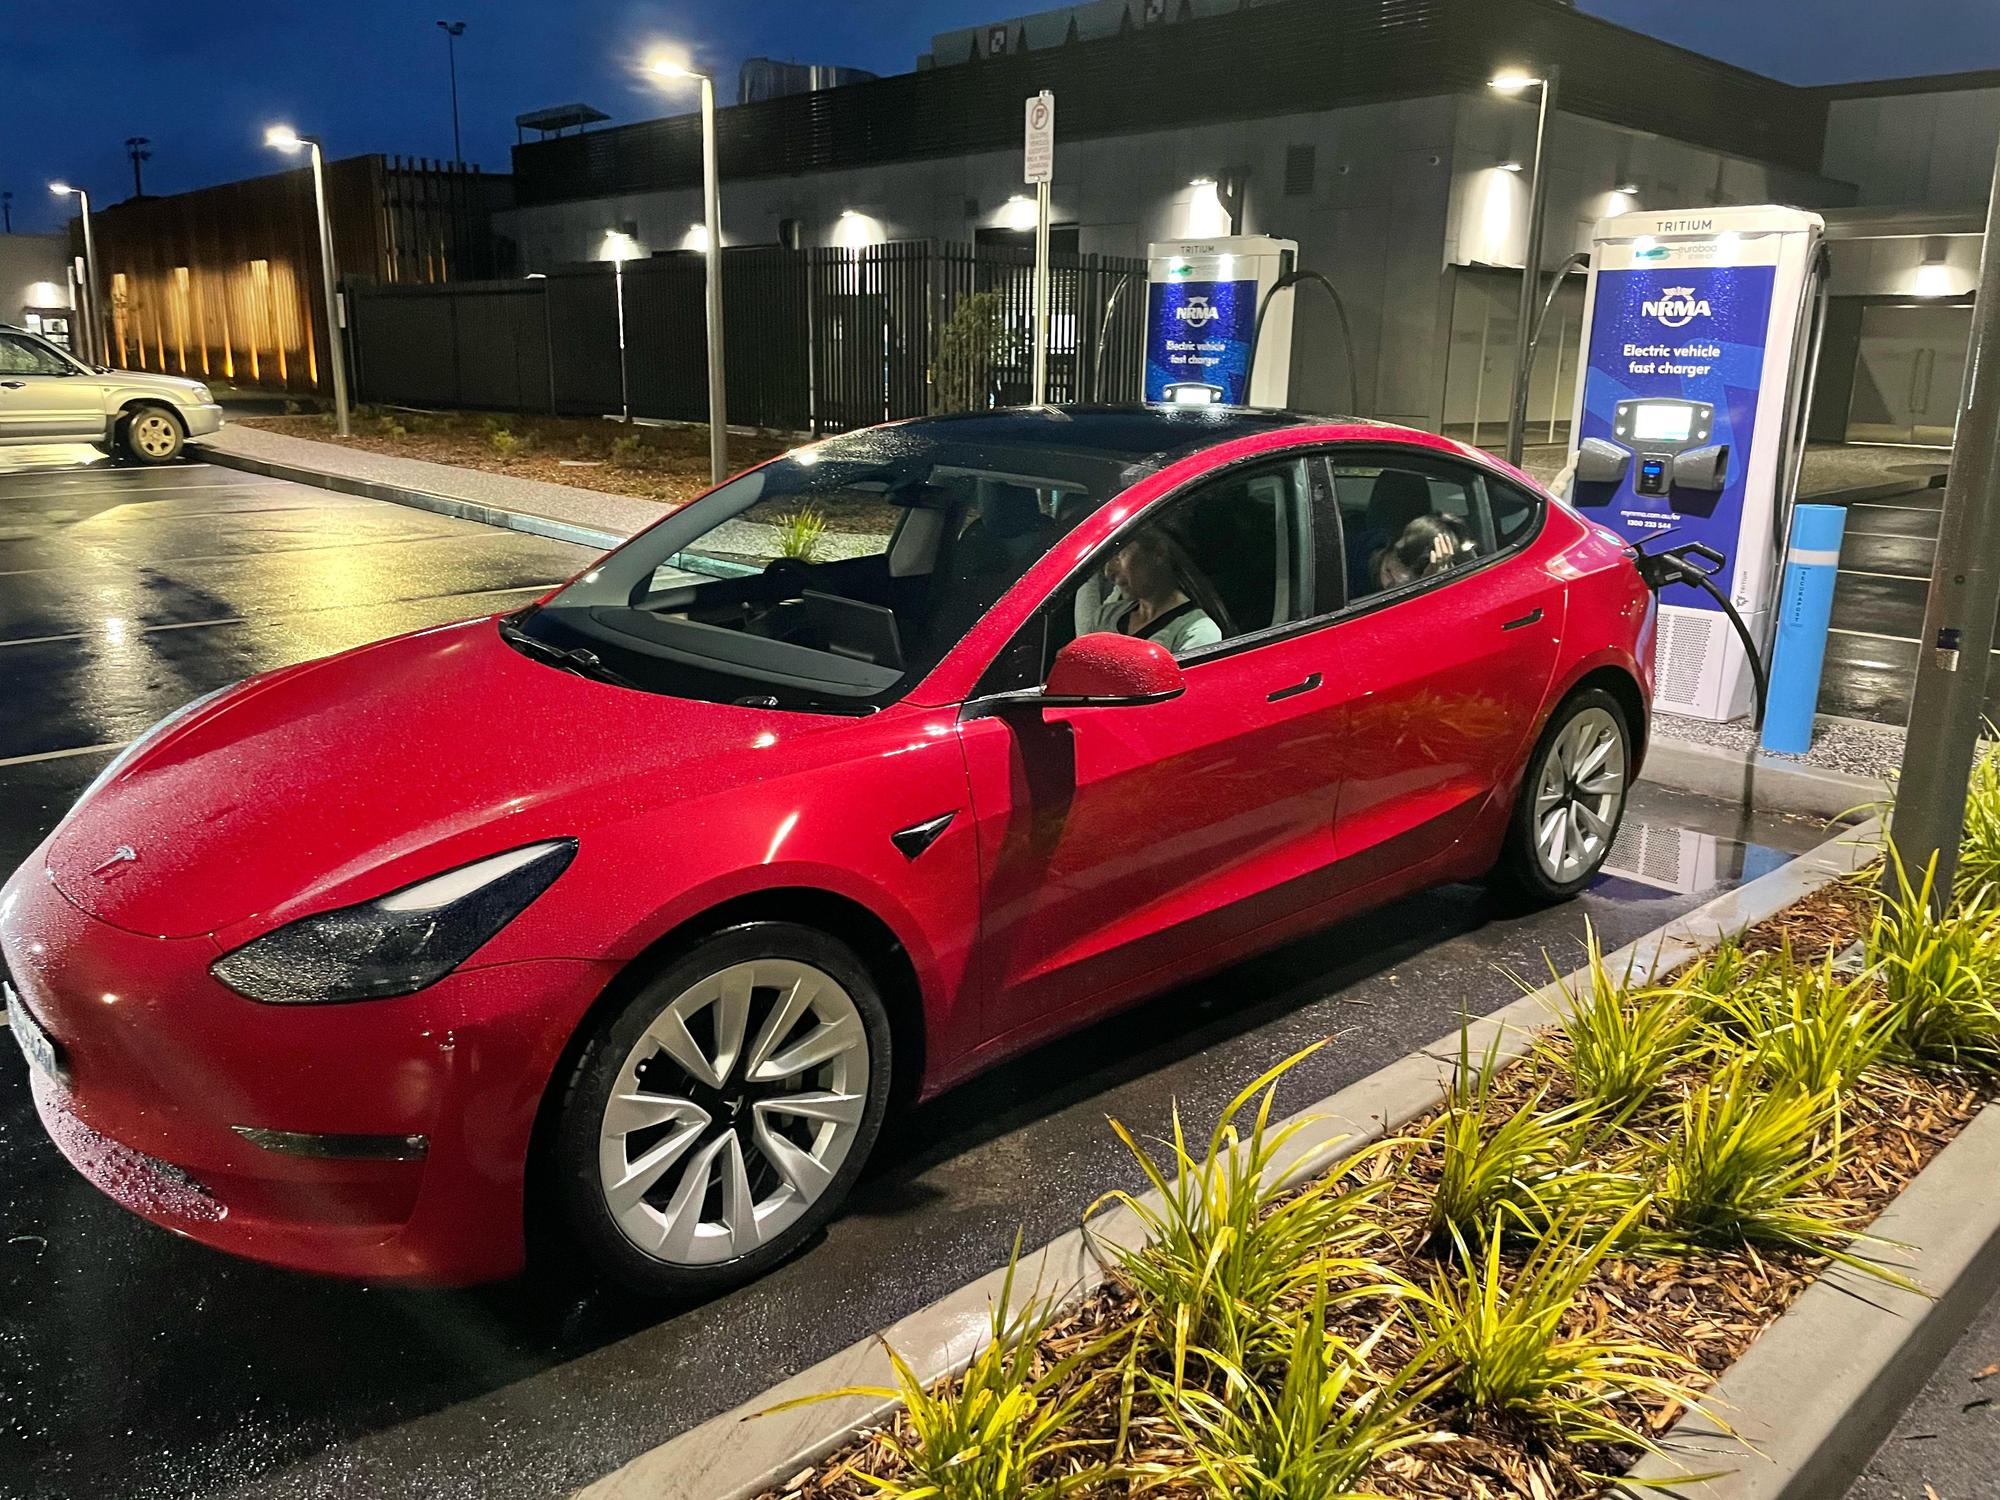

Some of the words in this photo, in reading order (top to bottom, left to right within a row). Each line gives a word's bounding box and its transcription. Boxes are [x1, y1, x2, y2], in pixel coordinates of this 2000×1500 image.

[1656, 219, 1713, 232] TRITIUM
[1180, 245, 1215, 254] TRITIUM
[1176, 306, 1220, 320] NRMA
[1641, 300, 1712, 317] NRMA
[1165, 340, 1195, 351] Electric
[1623, 344, 1671, 357] Electric
[1673, 344, 1721, 357] vehicle
[1170, 354, 1187, 364] fast
[1187, 354, 1220, 367] charger
[1628, 361, 1656, 374] fast
[1657, 361, 1711, 378] charger
